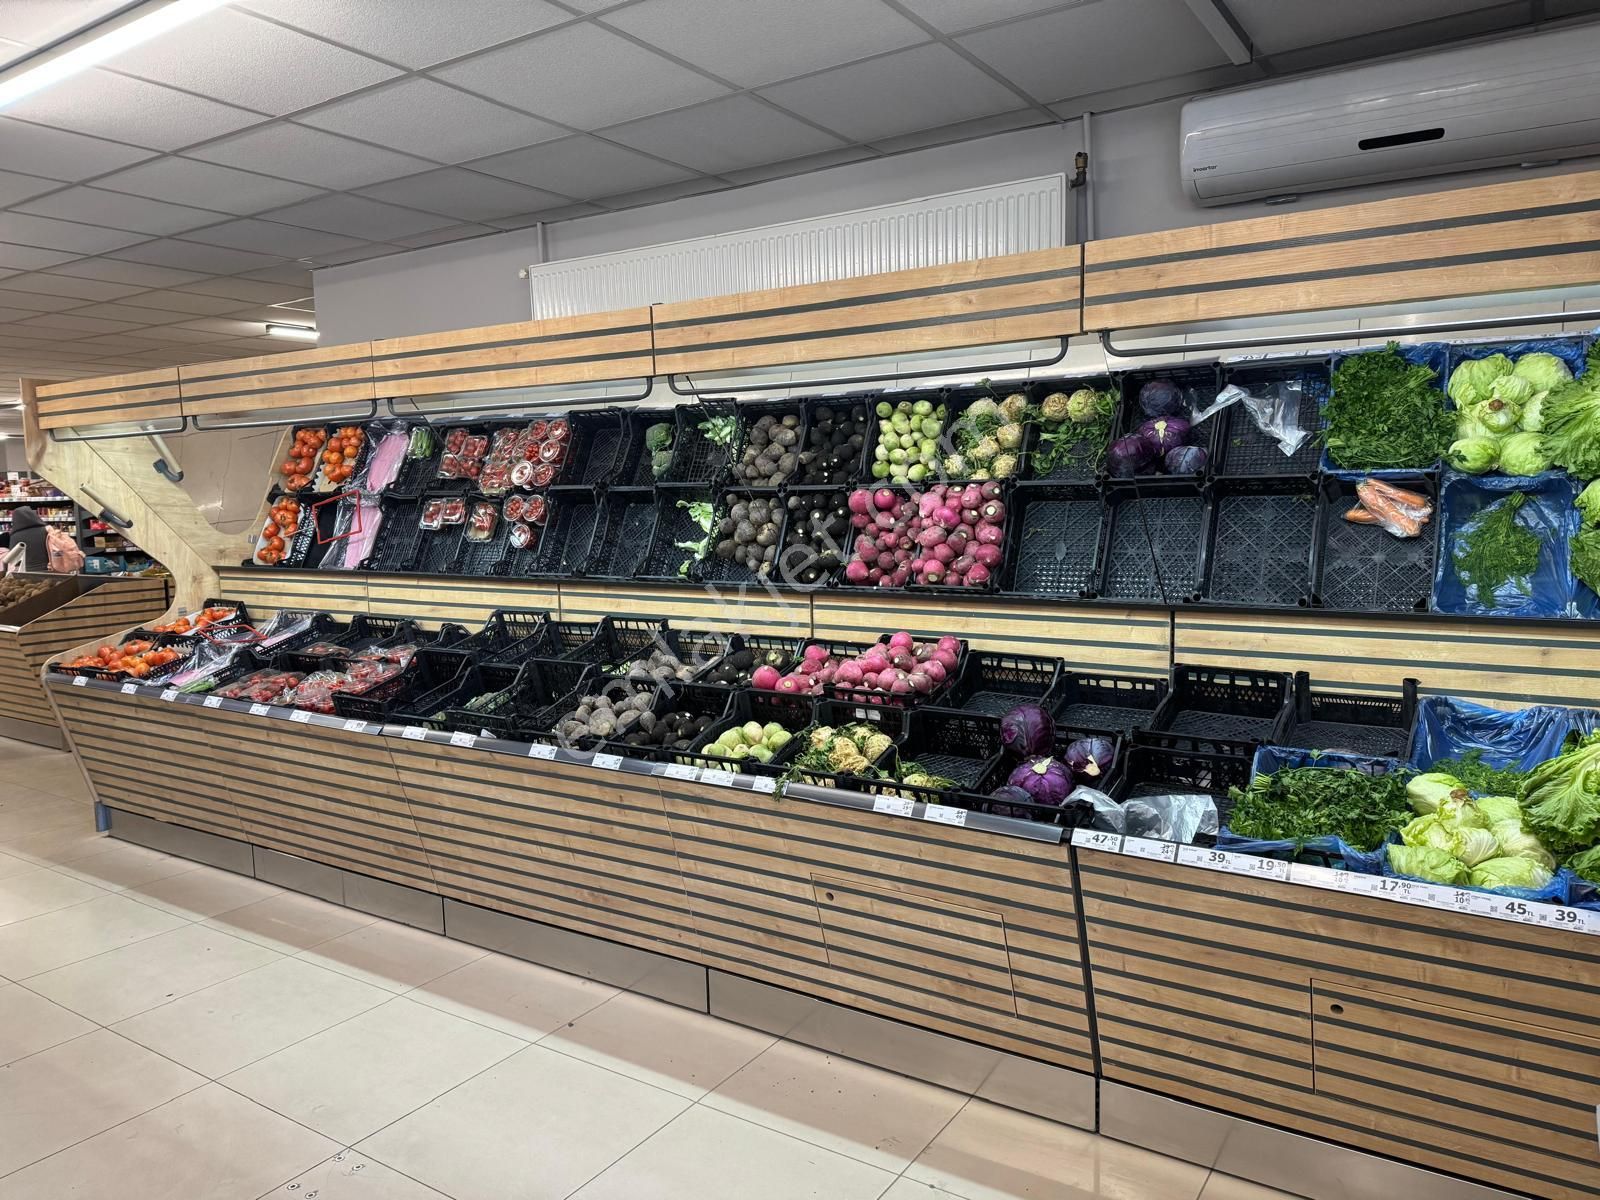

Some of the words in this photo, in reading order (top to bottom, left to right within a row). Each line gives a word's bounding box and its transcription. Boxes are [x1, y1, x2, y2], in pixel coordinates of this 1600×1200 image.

[1208, 851, 1226, 863] 39
[1505, 901, 1527, 915] 45
[1555, 909, 1578, 923] 39
